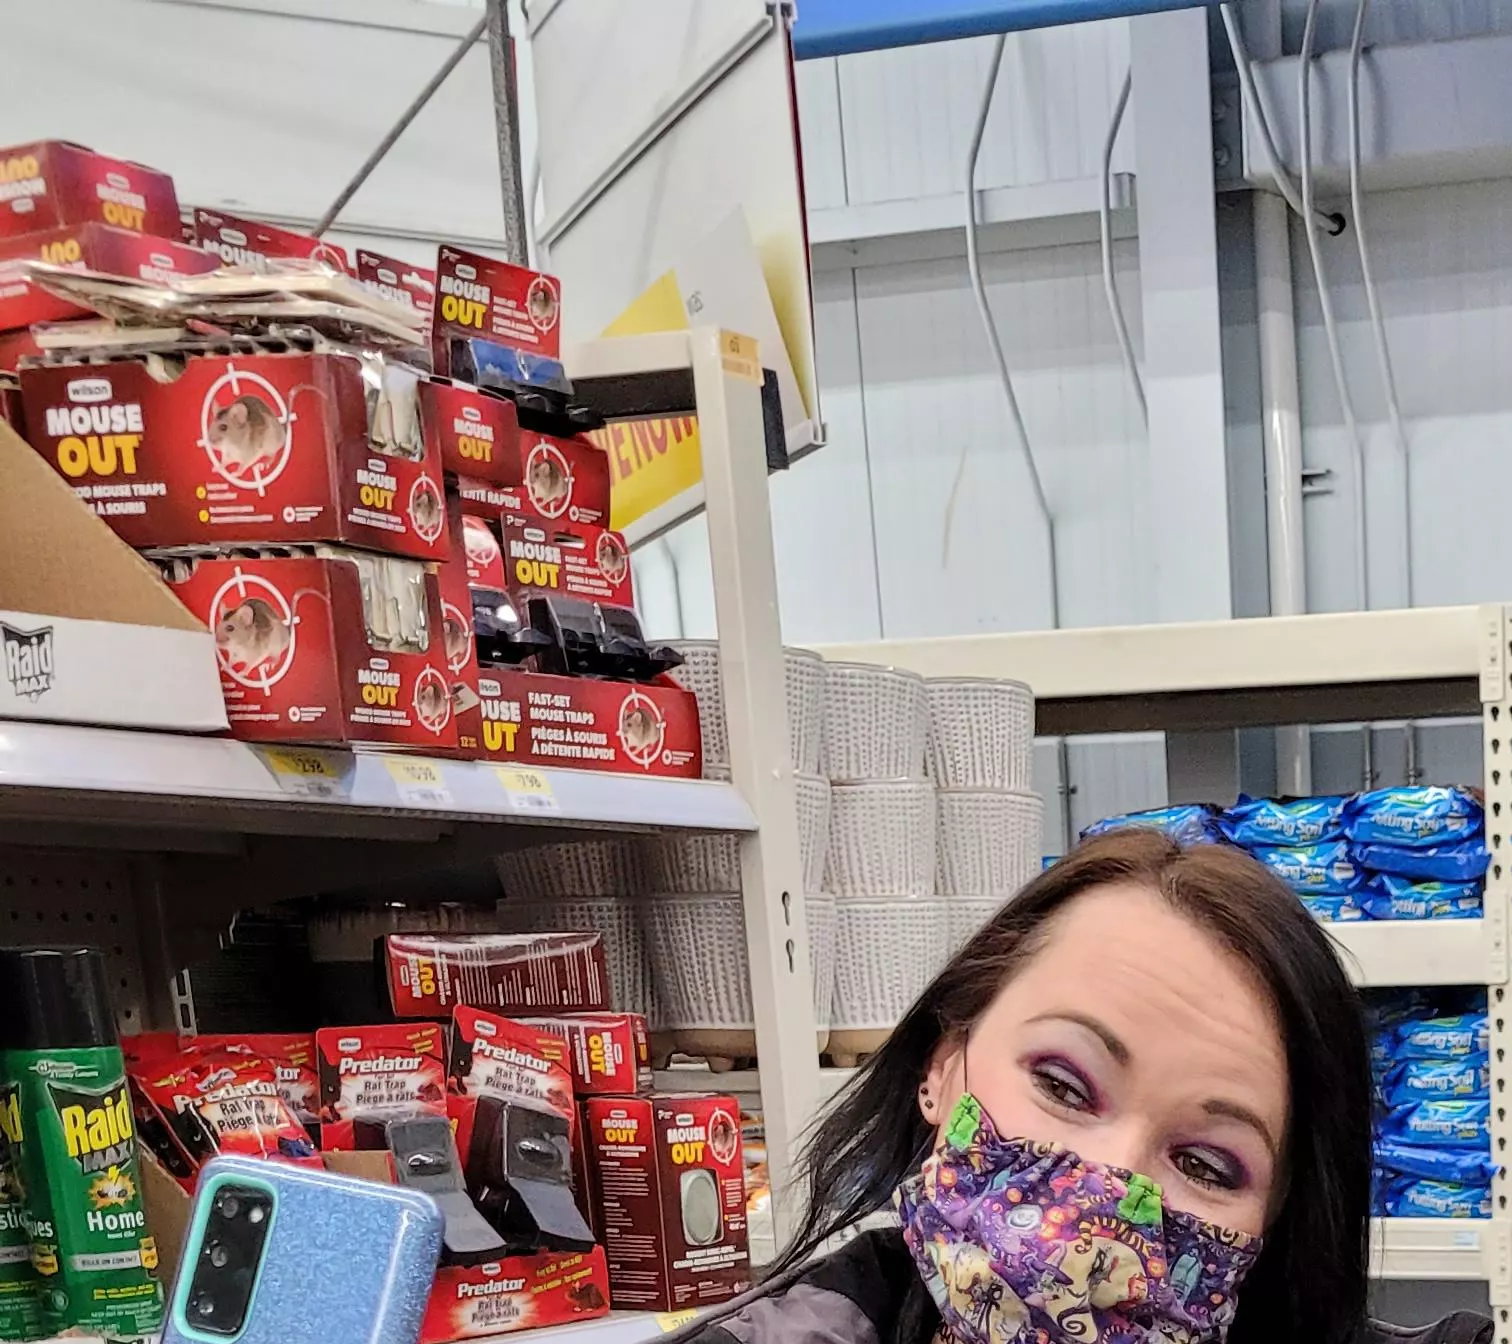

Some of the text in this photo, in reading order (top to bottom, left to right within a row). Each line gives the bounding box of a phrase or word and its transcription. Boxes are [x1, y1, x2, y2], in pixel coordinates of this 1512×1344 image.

[103, 203, 144, 231] OUT
[440, 275, 490, 304] MOUSE
[442, 296, 487, 329] OUT
[71, 384, 109, 396] wilson
[46, 404, 143, 436] MOUSE
[454, 418, 494, 441] MOUSE
[58, 435, 140, 477] OUT
[458, 436, 492, 462] OUT
[93, 484, 132, 498] MOUSE
[132, 483, 166, 497] TRAPS
[357, 469, 396, 491] MOUSE
[106, 501, 146, 515] SOURIS
[360, 485, 395, 510] OUT
[510, 540, 561, 563] MOUSE
[516, 560, 559, 588] OUT
[6, 633, 52, 681] Raid
[16, 675, 50, 695] MAX
[358, 669, 401, 685] MOUSE
[362, 685, 399, 706] OUT
[528, 692, 571, 707] FAST-SET
[530, 708, 594, 725] MOUSE TRAPS
[483, 721, 518, 752] UT
[531, 726, 566, 744] PIÈGES
[574, 731, 607, 745] SOURIS
[540, 743, 582, 759] DÉTENTE
[582, 747, 616, 761] RAPIDE
[339, 1056, 423, 1074] Predator
[472, 1037, 552, 1074] Predator
[589, 1034, 606, 1074] OUT
[364, 1080, 407, 1092] Rat Trap
[495, 1066, 536, 1087] Rat Trap
[220, 1101, 241, 1116] Rat
[62, 1089, 132, 1157] Raid
[602, 1119, 638, 1130] MOUSE
[605, 1130, 636, 1143] OUT
[667, 1127, 706, 1143] MOUSE
[83, 1139, 131, 1173] MAX
[672, 1142, 704, 1164] OUT
[86, 1210, 145, 1232] Home
[457, 1277, 526, 1299] Predator
